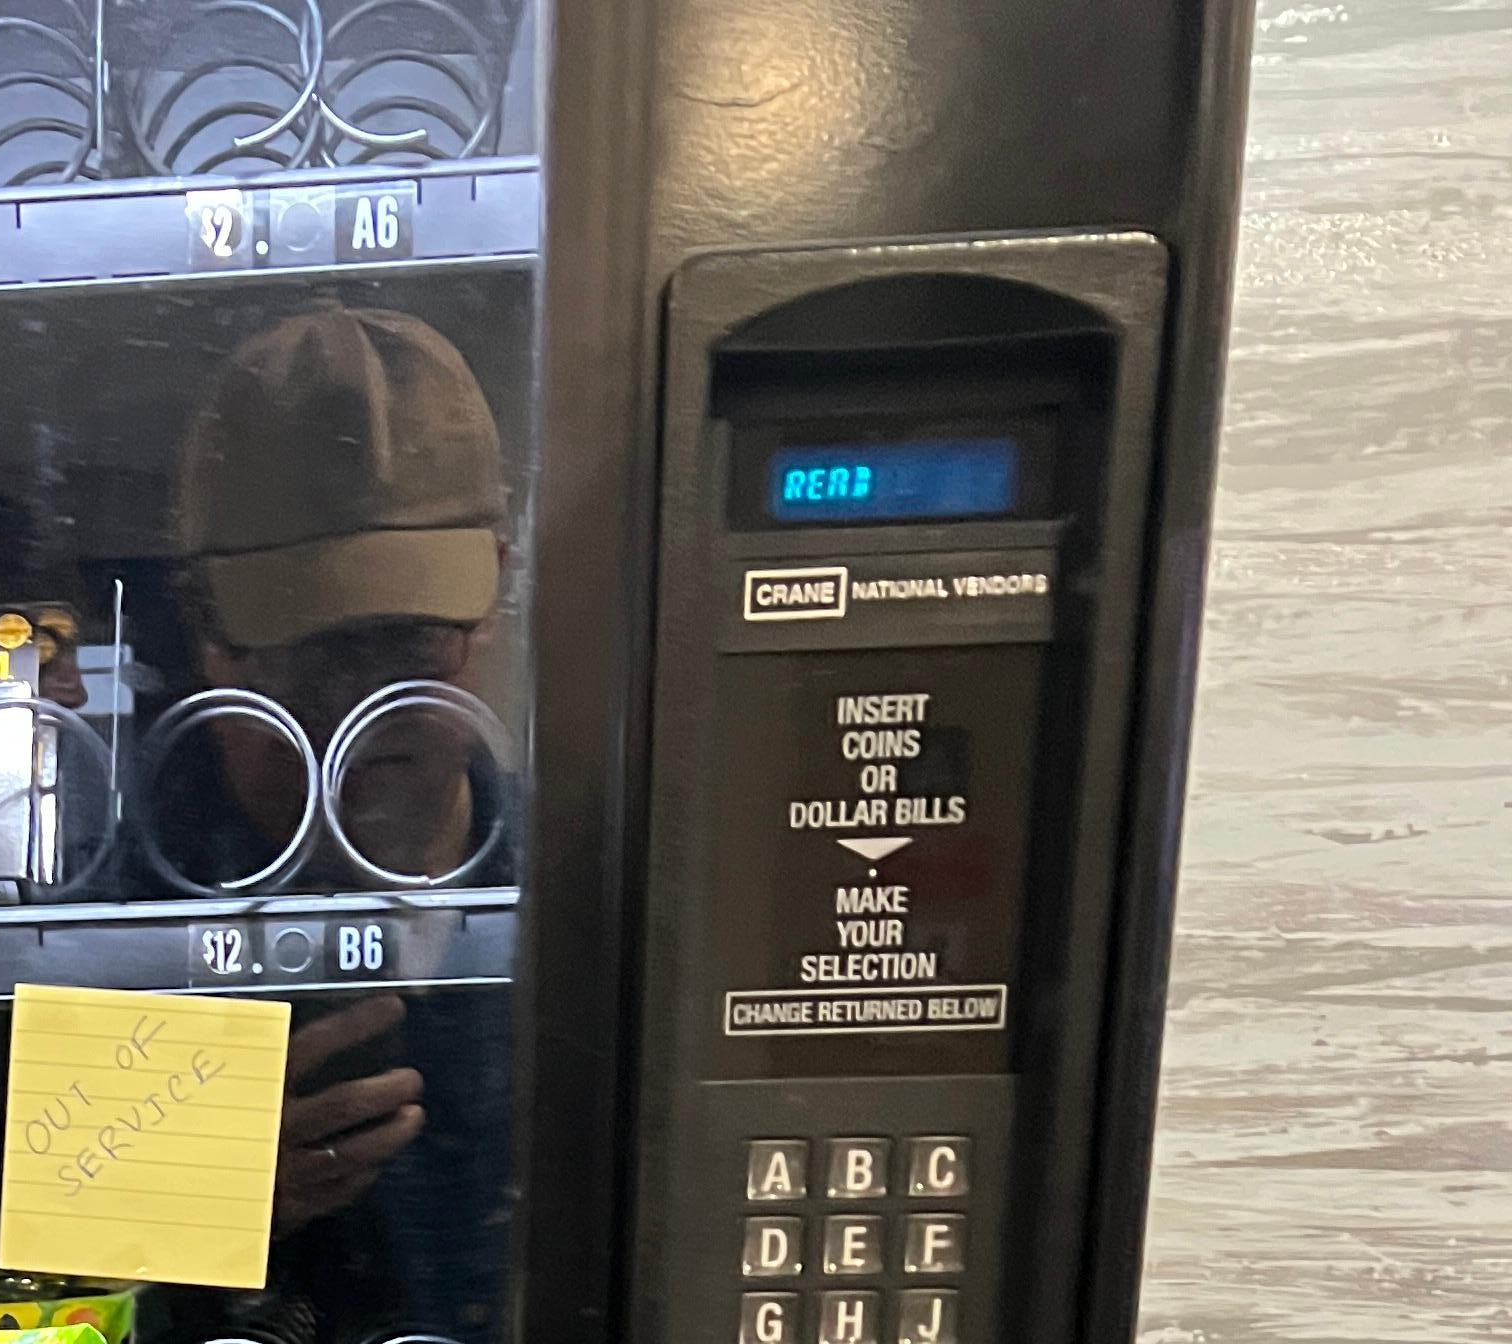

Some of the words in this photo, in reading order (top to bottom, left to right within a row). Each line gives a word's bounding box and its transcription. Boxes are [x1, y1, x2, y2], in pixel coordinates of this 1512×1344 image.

[352, 196, 399, 249] A6
[756, 579, 836, 607] CRANE
[851, 577, 949, 601] NATIONAL
[953, 573, 1048, 597] VENDORS
[838, 693, 930, 725] INSERT
[842, 729, 921, 760] COINS
[860, 764, 897, 793] OR
[790, 800, 888, 828] DOLLAR
[895, 796, 966, 825] BILLS
[836, 886, 909, 914] MAKE
[338, 926, 384, 970] B6
[837, 919, 904, 947] YOUR
[800, 953, 937, 982] SELECTION
[733, 1001, 814, 1025] CHANGE
[818, 999, 922, 1023] RETURNED
[927, 996, 999, 1019] BELOW
[24, 1079, 92, 1155] OUT
[114, 1014, 167, 1070] OF
[57, 1048, 226, 1198] SERVICE
[761, 1151, 792, 1192] A
[846, 1149, 874, 1191] B
[928, 1145, 956, 1189] C
[760, 1227, 788, 1268] D
[842, 1226, 867, 1267] E
[923, 1223, 952, 1265] F
[756, 1301, 784, 1342] G
[837, 1300, 864, 1340] H
[917, 1298, 942, 1341] J
